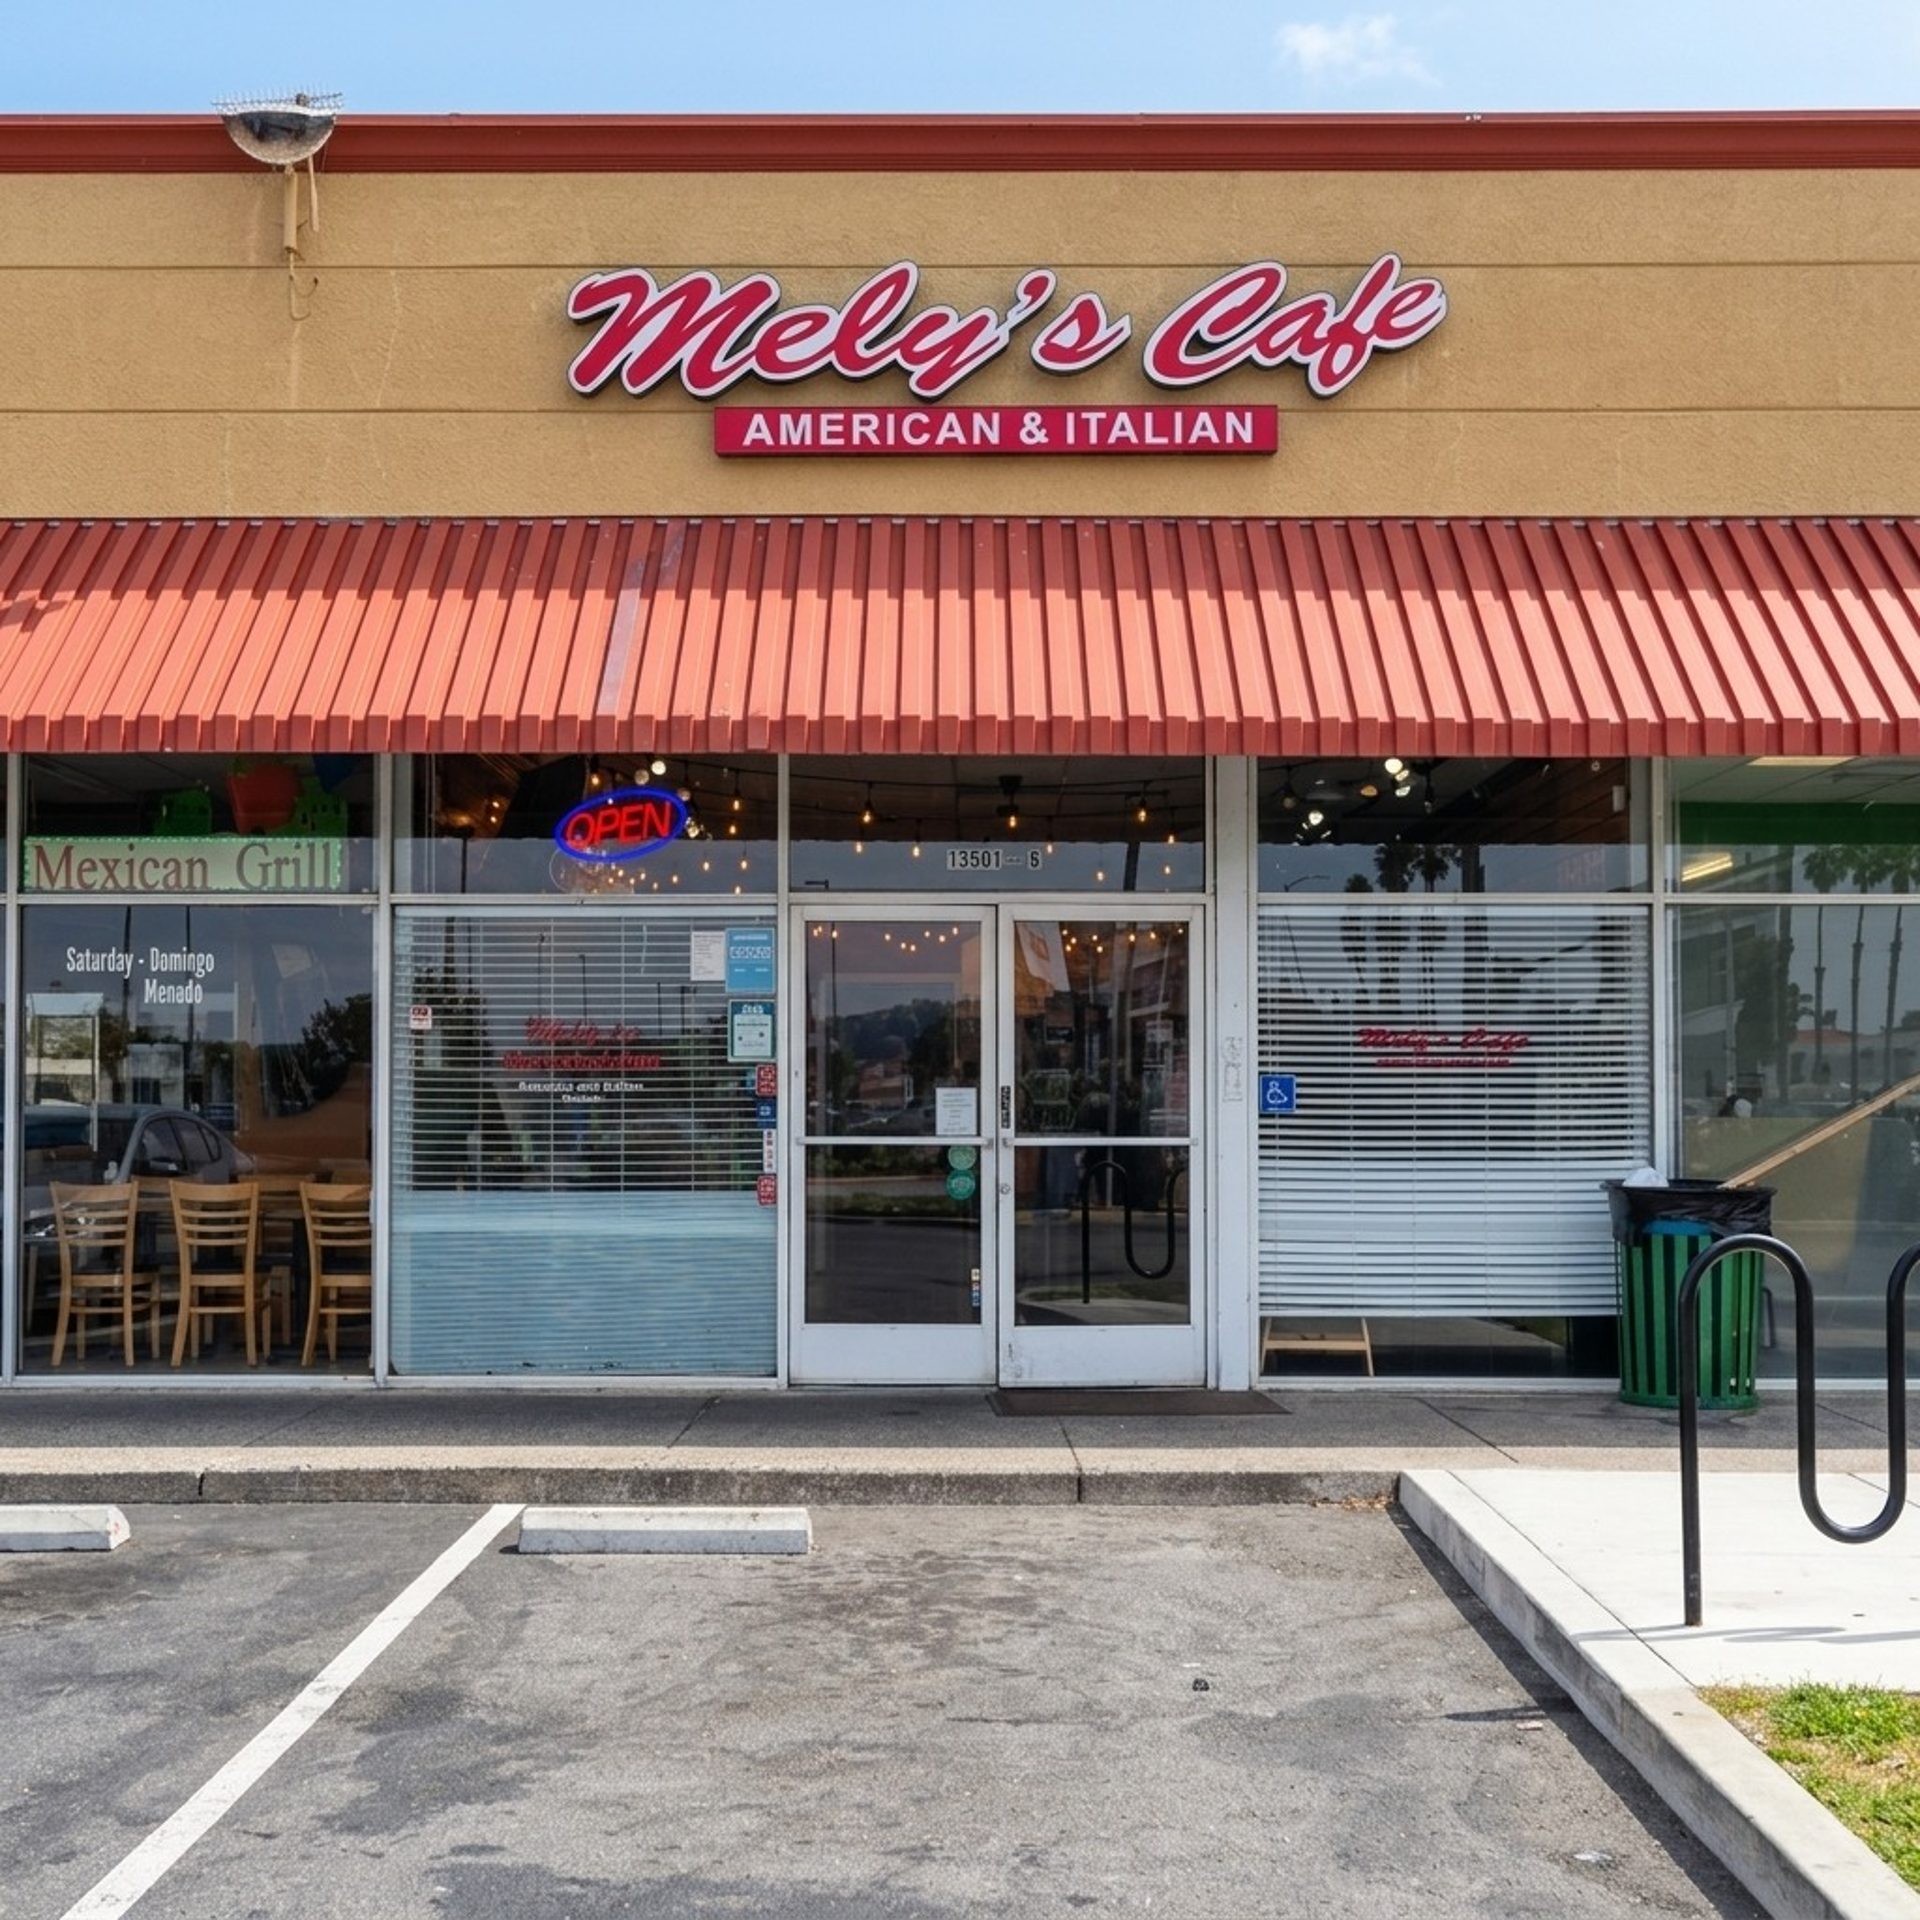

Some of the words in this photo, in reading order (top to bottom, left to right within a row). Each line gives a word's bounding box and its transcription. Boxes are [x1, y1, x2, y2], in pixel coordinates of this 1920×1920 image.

[566, 259, 1130, 400] Mely's
[1142, 253, 1446, 398] Cafe
[743, 413, 1000, 446] AMERICAN
[1019, 413, 1048, 445] &
[1067, 412, 1253, 445] ITALIAN
[566, 801, 671, 849] OPEN
[34, 843, 209, 889] Mexican
[236, 842, 331, 889] Grill
[949, 850, 1000, 868] 13501
